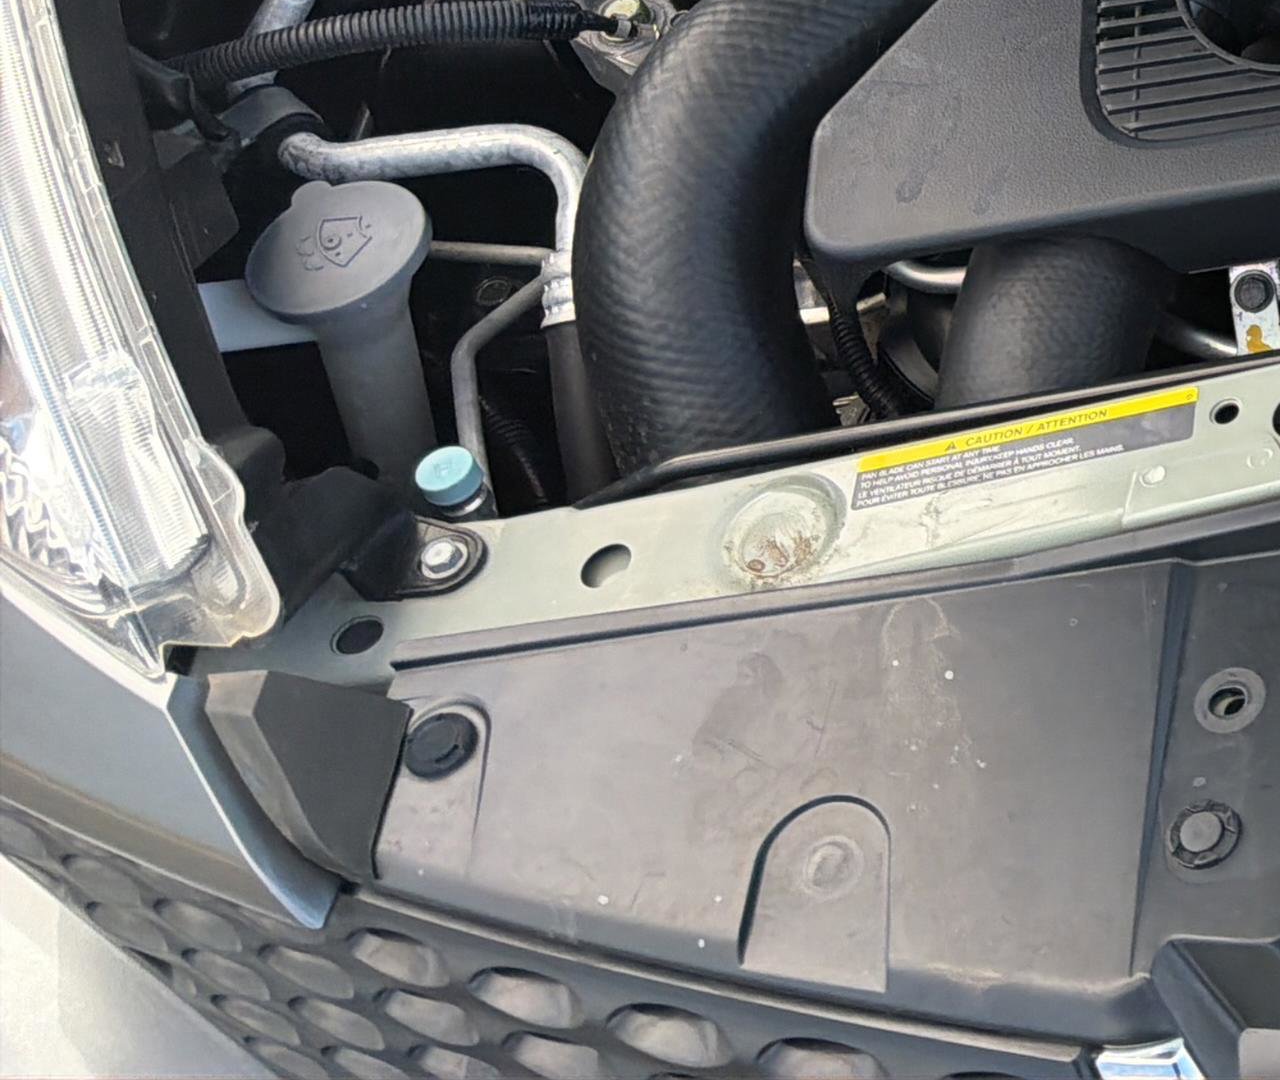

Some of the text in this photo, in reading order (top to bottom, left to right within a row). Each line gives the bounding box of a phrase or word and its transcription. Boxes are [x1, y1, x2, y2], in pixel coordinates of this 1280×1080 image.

[966, 427, 1022, 448] CAUTION
[1037, 408, 1108, 432] ATTENTION
[861, 481, 871, 490] TO
